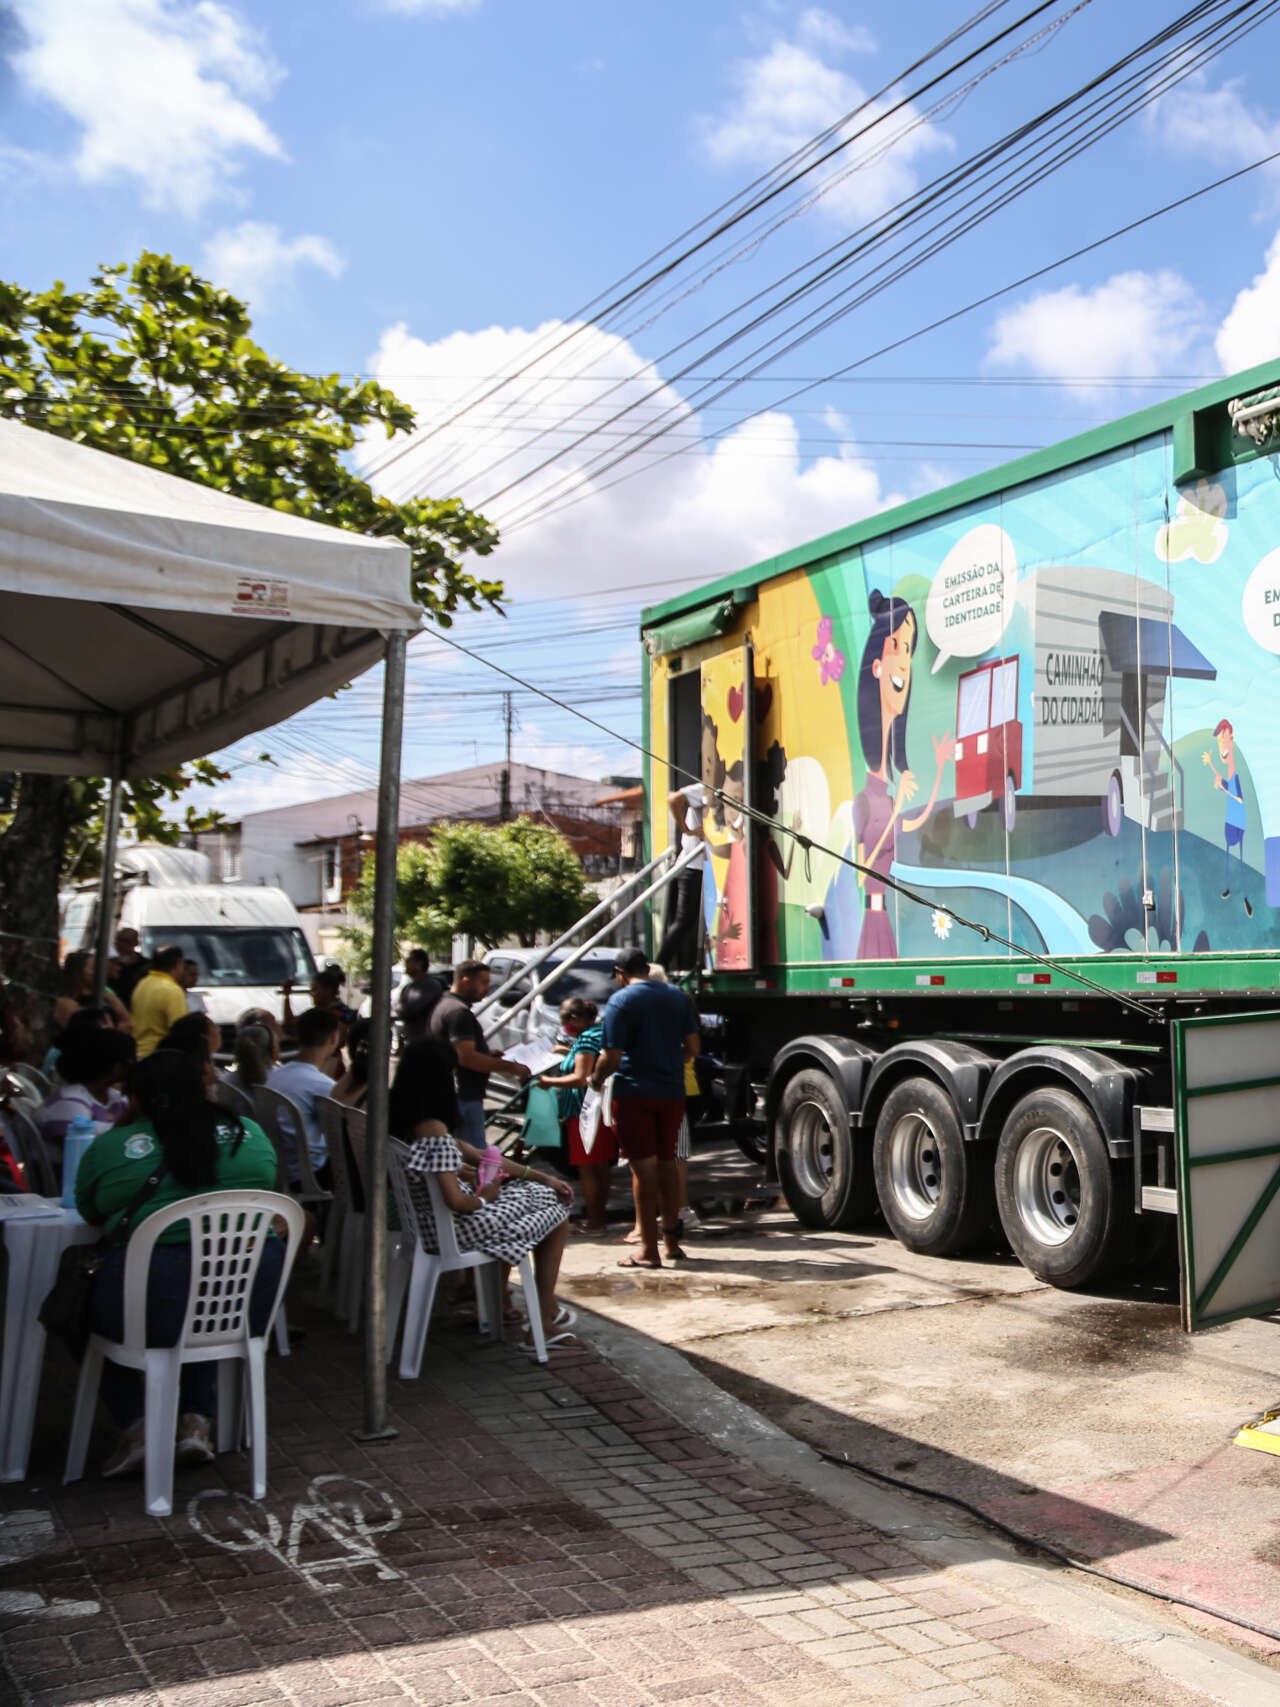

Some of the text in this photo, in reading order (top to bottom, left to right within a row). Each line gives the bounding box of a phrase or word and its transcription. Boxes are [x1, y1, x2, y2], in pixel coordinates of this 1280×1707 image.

[944, 560, 1000, 589] EMISSÃO DA
[943, 580, 1002, 608] CARTEIRA DE
[944, 601, 1001, 628] IDENTIDADE
[1046, 649, 1104, 686] CAMINHÃO
[1042, 690, 1104, 724] DO CIDADÃO
